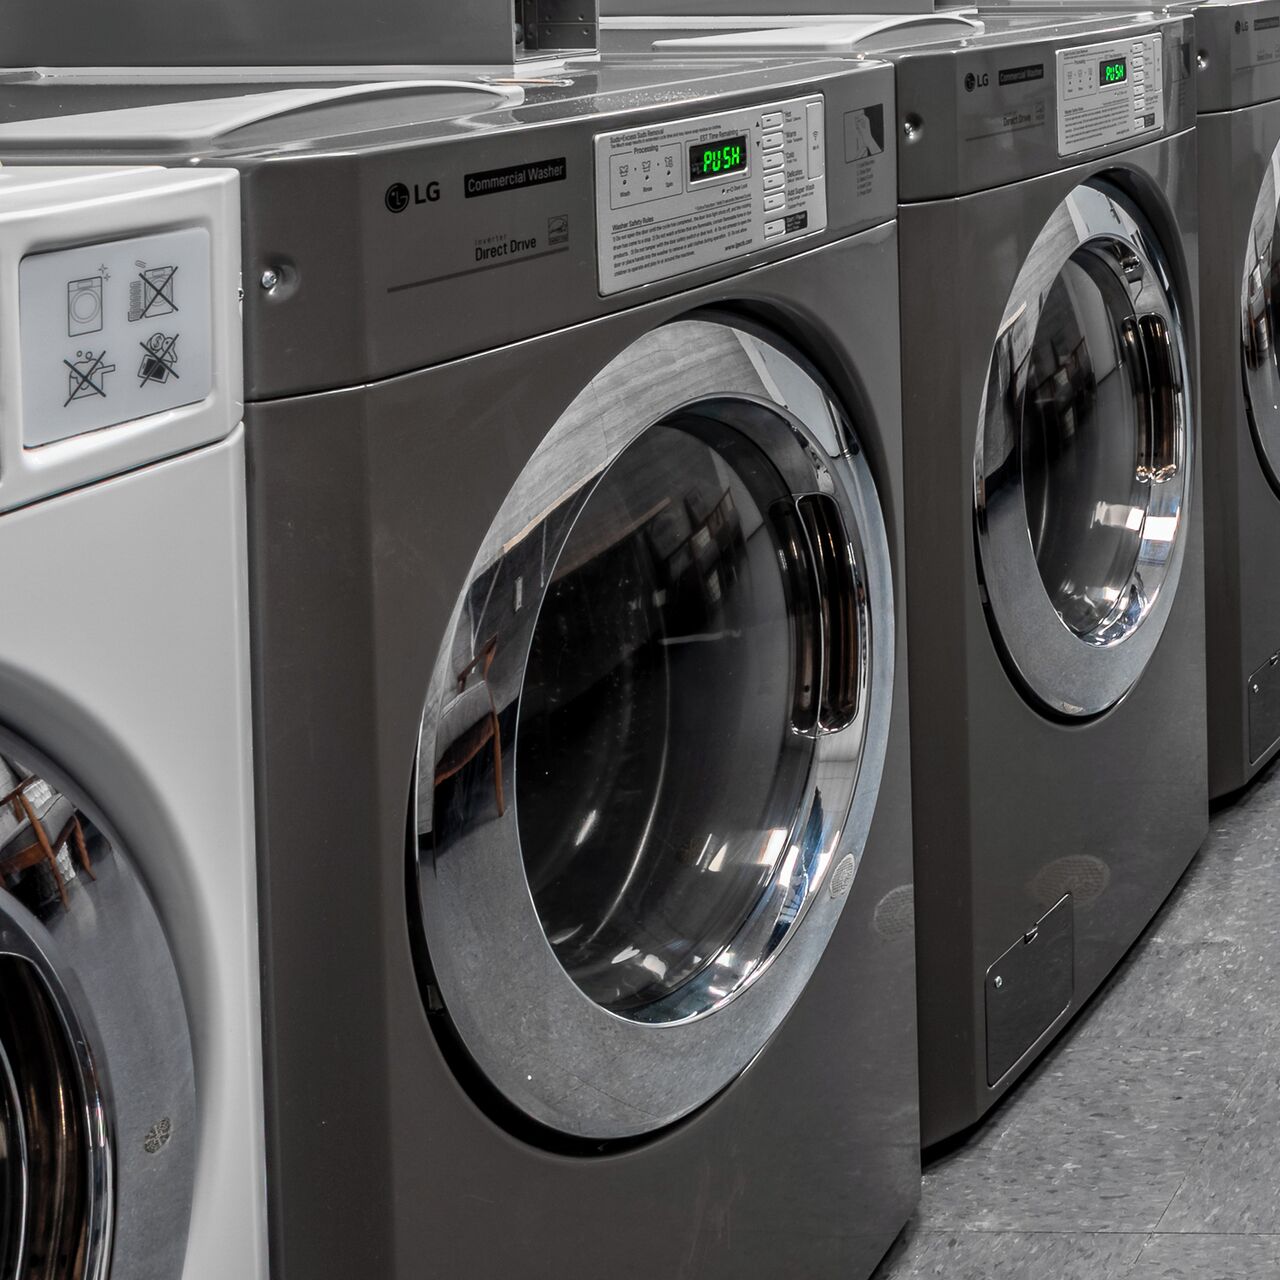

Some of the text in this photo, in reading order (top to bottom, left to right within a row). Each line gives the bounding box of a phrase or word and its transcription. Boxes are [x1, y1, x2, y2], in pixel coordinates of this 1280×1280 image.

[977, 72, 989, 88] LG
[1105, 63, 1124, 82] PUSH
[633, 144, 659, 155] Processing
[703, 145, 741, 173] PUSH
[467, 164, 564, 193] Commercial Washer
[414, 181, 441, 205] LG
[475, 243, 508, 261] Direct
[510, 237, 537, 253] Drive
